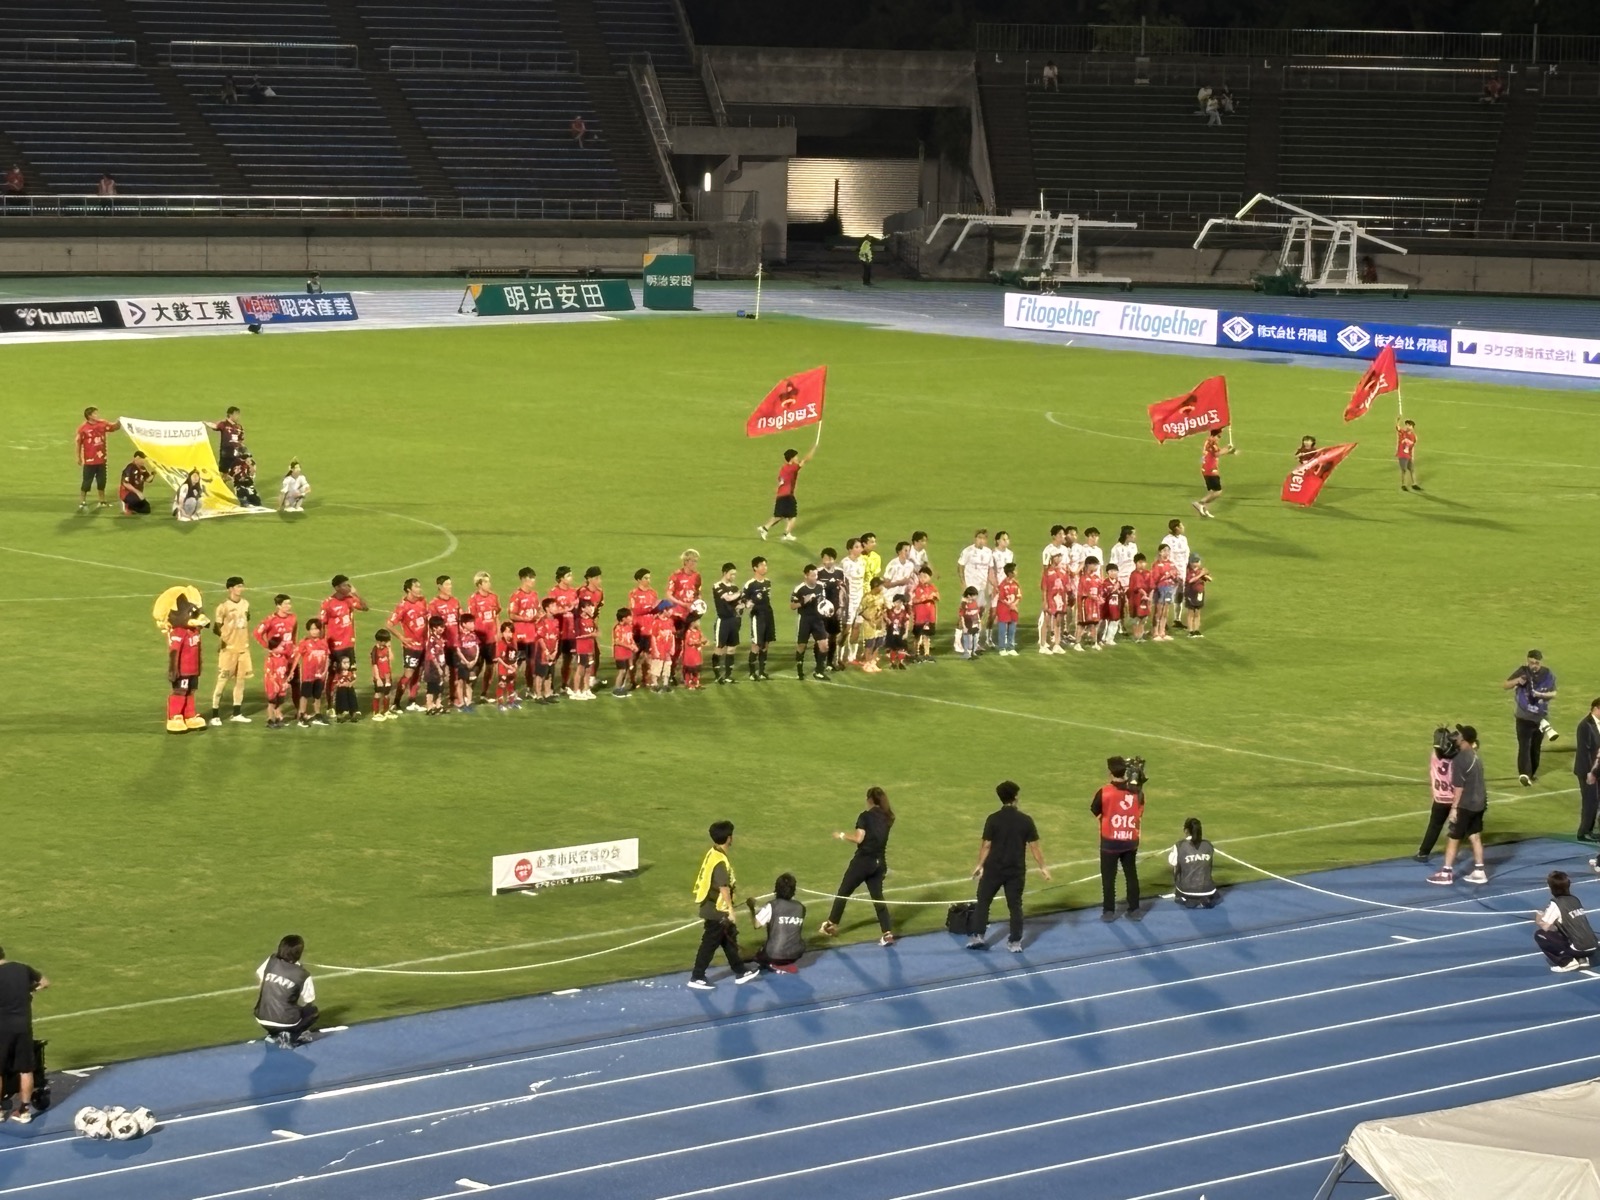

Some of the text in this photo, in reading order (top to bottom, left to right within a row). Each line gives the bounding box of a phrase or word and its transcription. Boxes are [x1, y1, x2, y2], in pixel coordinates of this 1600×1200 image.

[645, 274, 692, 287] 明治安田
[279, 297, 353, 317] 昭栄産業
[503, 284, 605, 311] 明治安田
[37, 306, 103, 325] hummel
[151, 300, 234, 322] 大鉄工業
[1016, 296, 1208, 337] Fitogether Fitogether
[265, 973, 296, 989] STAFF
